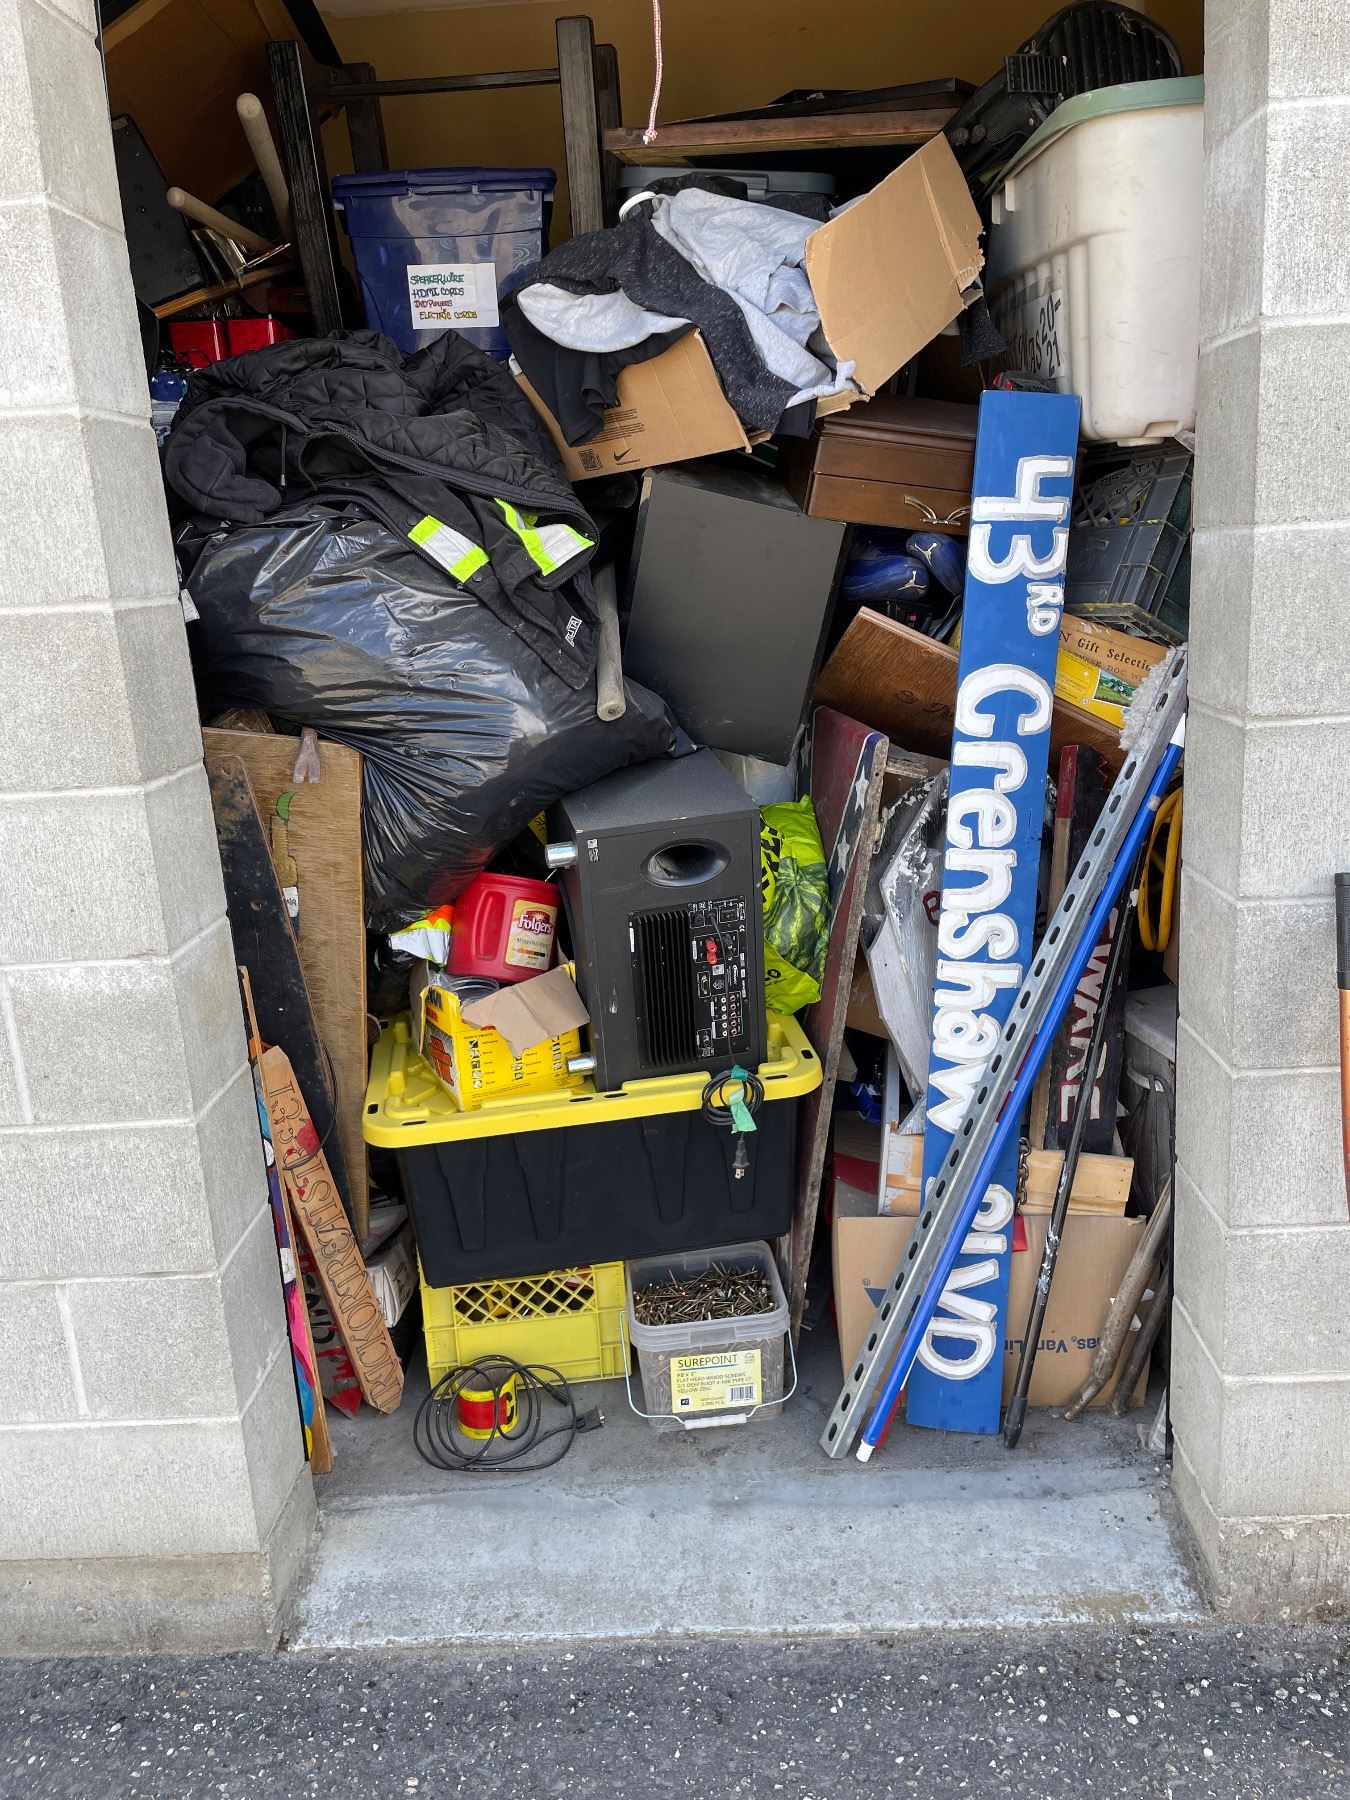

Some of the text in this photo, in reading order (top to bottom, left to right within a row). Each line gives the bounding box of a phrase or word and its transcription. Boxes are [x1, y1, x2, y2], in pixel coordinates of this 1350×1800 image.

[412, 287, 464, 298] HDMI CORDS
[1077, 637, 1100, 653] Gift
[1107, 648, 1152, 672] Selectio
[518, 912, 552, 935] Folgers
[677, 1355, 738, 1368] SUREPOINT
